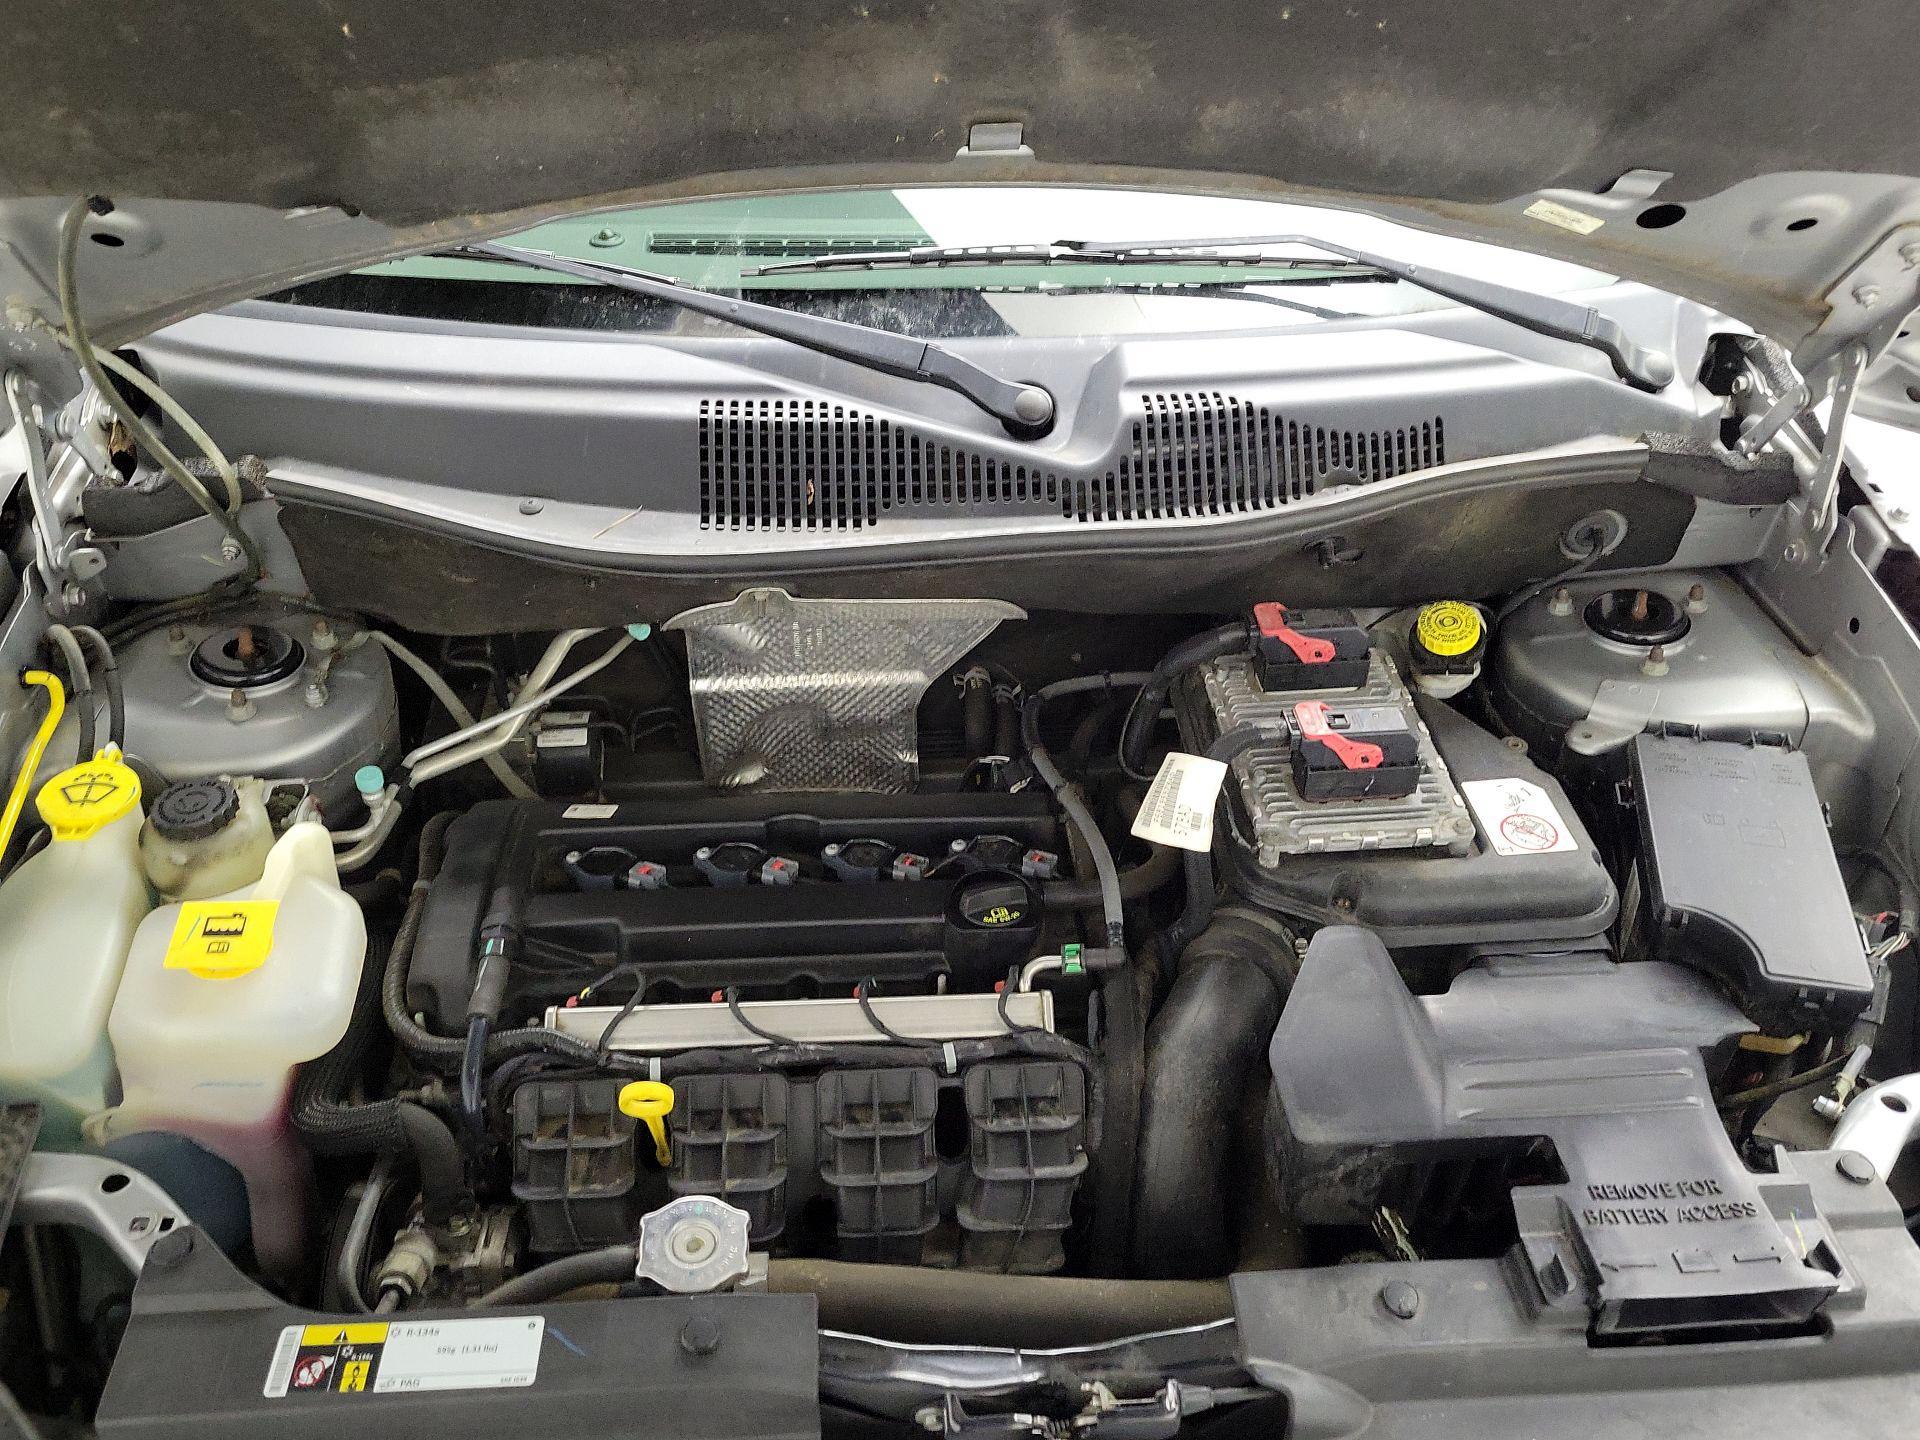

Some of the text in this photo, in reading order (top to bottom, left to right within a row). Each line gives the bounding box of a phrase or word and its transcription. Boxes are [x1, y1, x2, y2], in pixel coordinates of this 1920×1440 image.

[1588, 1179, 1723, 1201] REMOVE FOR
[1583, 1202, 1758, 1225] BATTERY ACCESS
